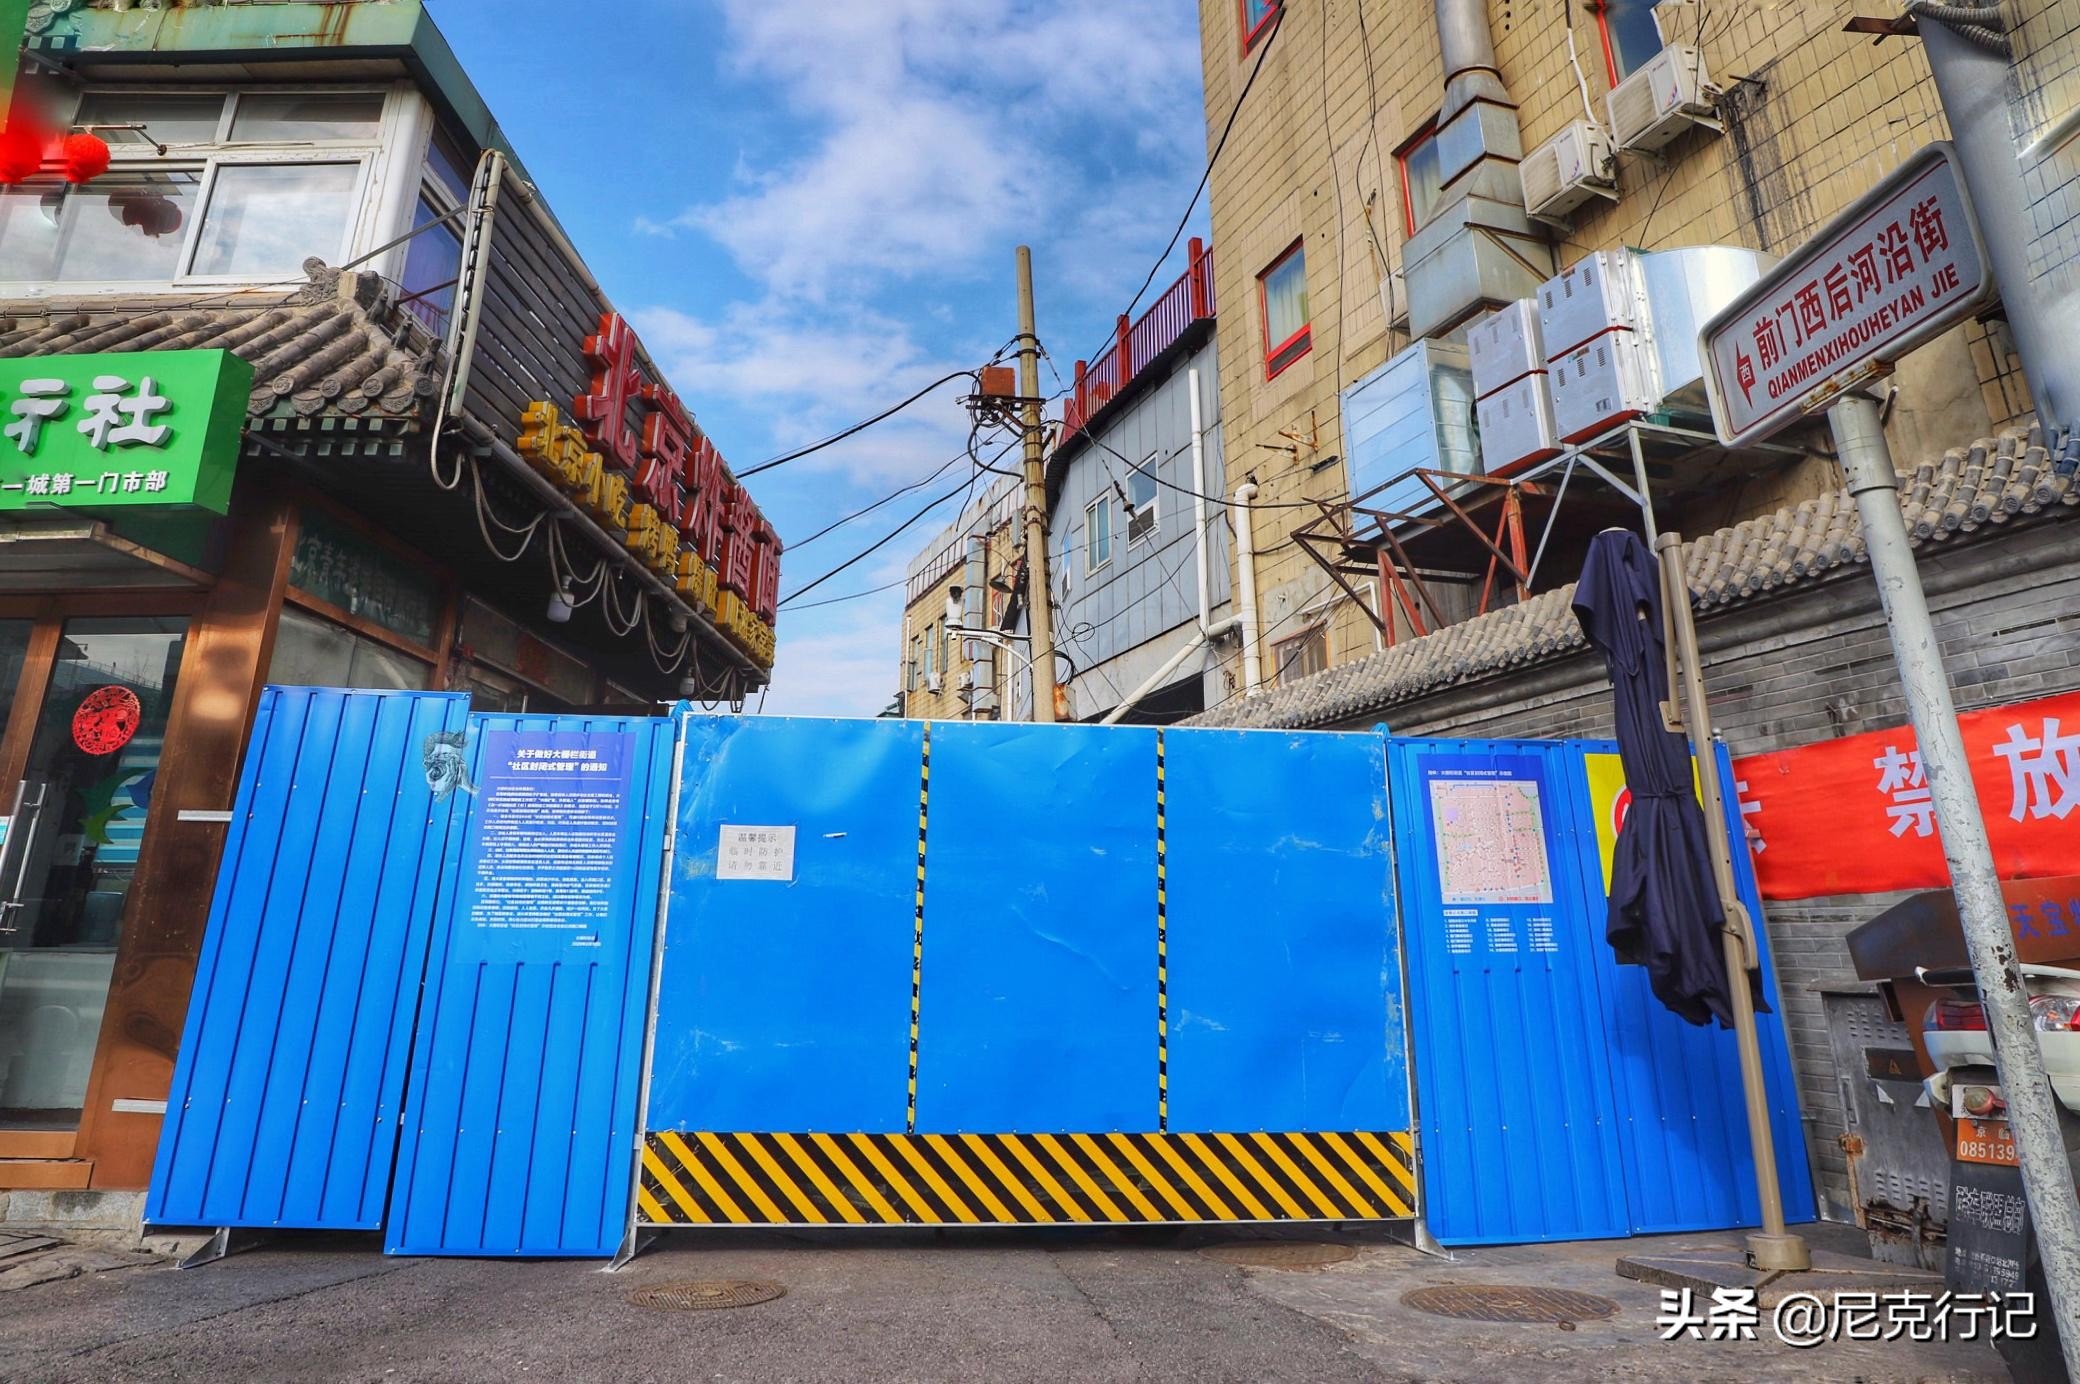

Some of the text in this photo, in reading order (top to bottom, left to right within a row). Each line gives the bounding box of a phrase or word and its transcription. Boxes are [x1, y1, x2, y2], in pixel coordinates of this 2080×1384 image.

[1752, 195, 1949, 371] 前门西后河沿街
[1768, 262, 1960, 400] QIANMENXIHOUHEYAN JIE
[738, 832, 777, 843] 温馨提示
[1959, 1140, 2017, 1161] 085139
